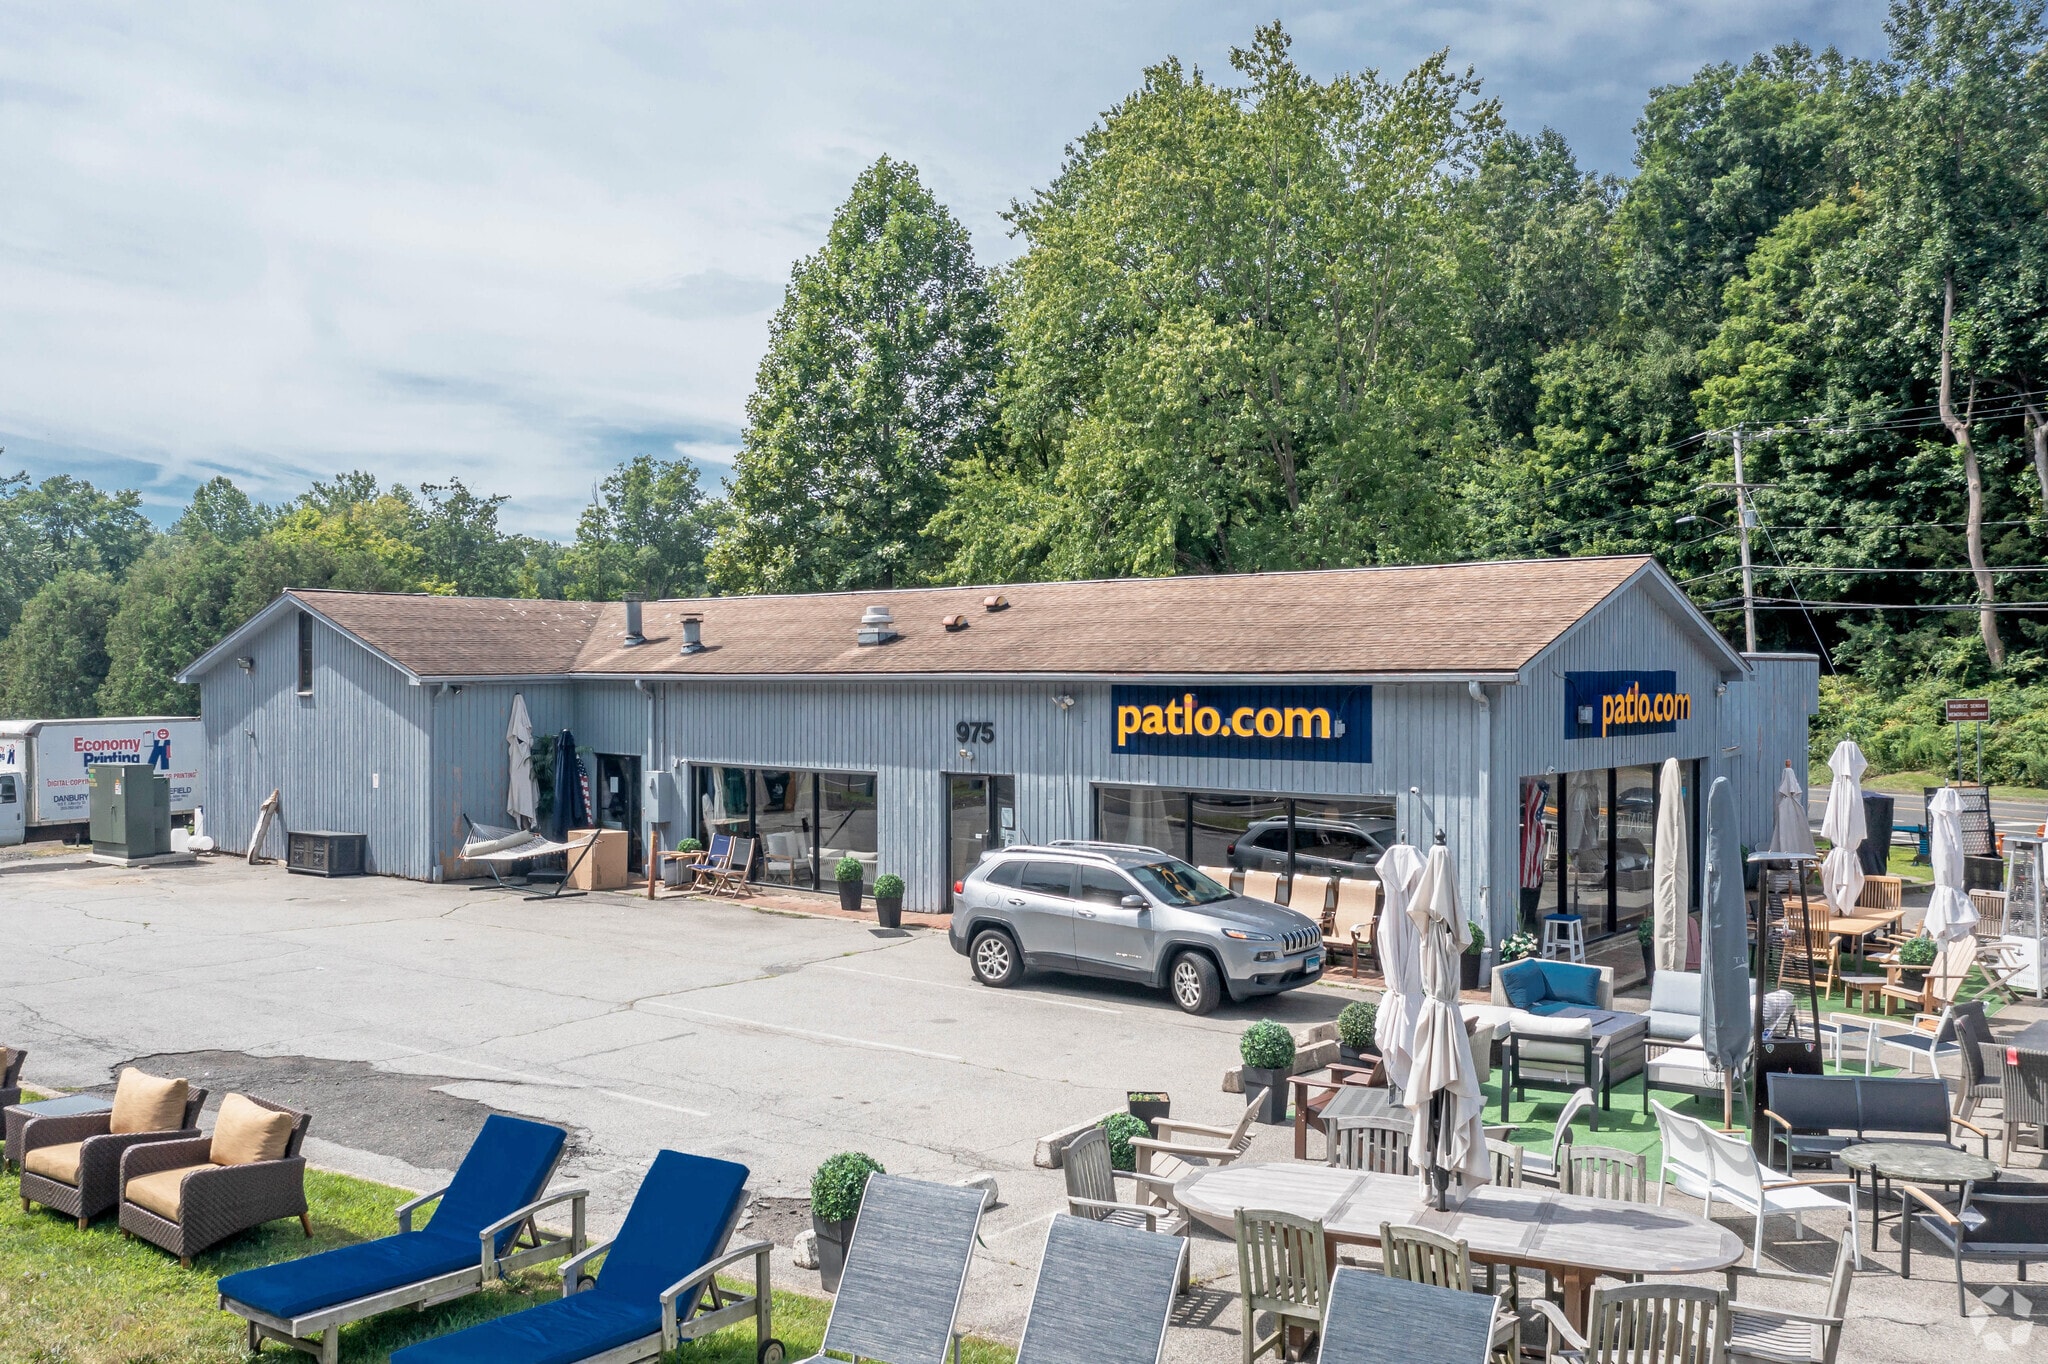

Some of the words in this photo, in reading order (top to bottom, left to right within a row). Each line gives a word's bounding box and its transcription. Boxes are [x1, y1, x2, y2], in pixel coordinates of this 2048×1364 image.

[1602, 681, 1691, 739] patio.com
[1118, 693, 1331, 746] patio.com
[956, 721, 995, 744] 975
[74, 737, 141, 752] Economy
[83, 751, 140, 767] Printing
[53, 794, 89, 803] DANBURY
[170, 787, 192, 795] EFIELD
